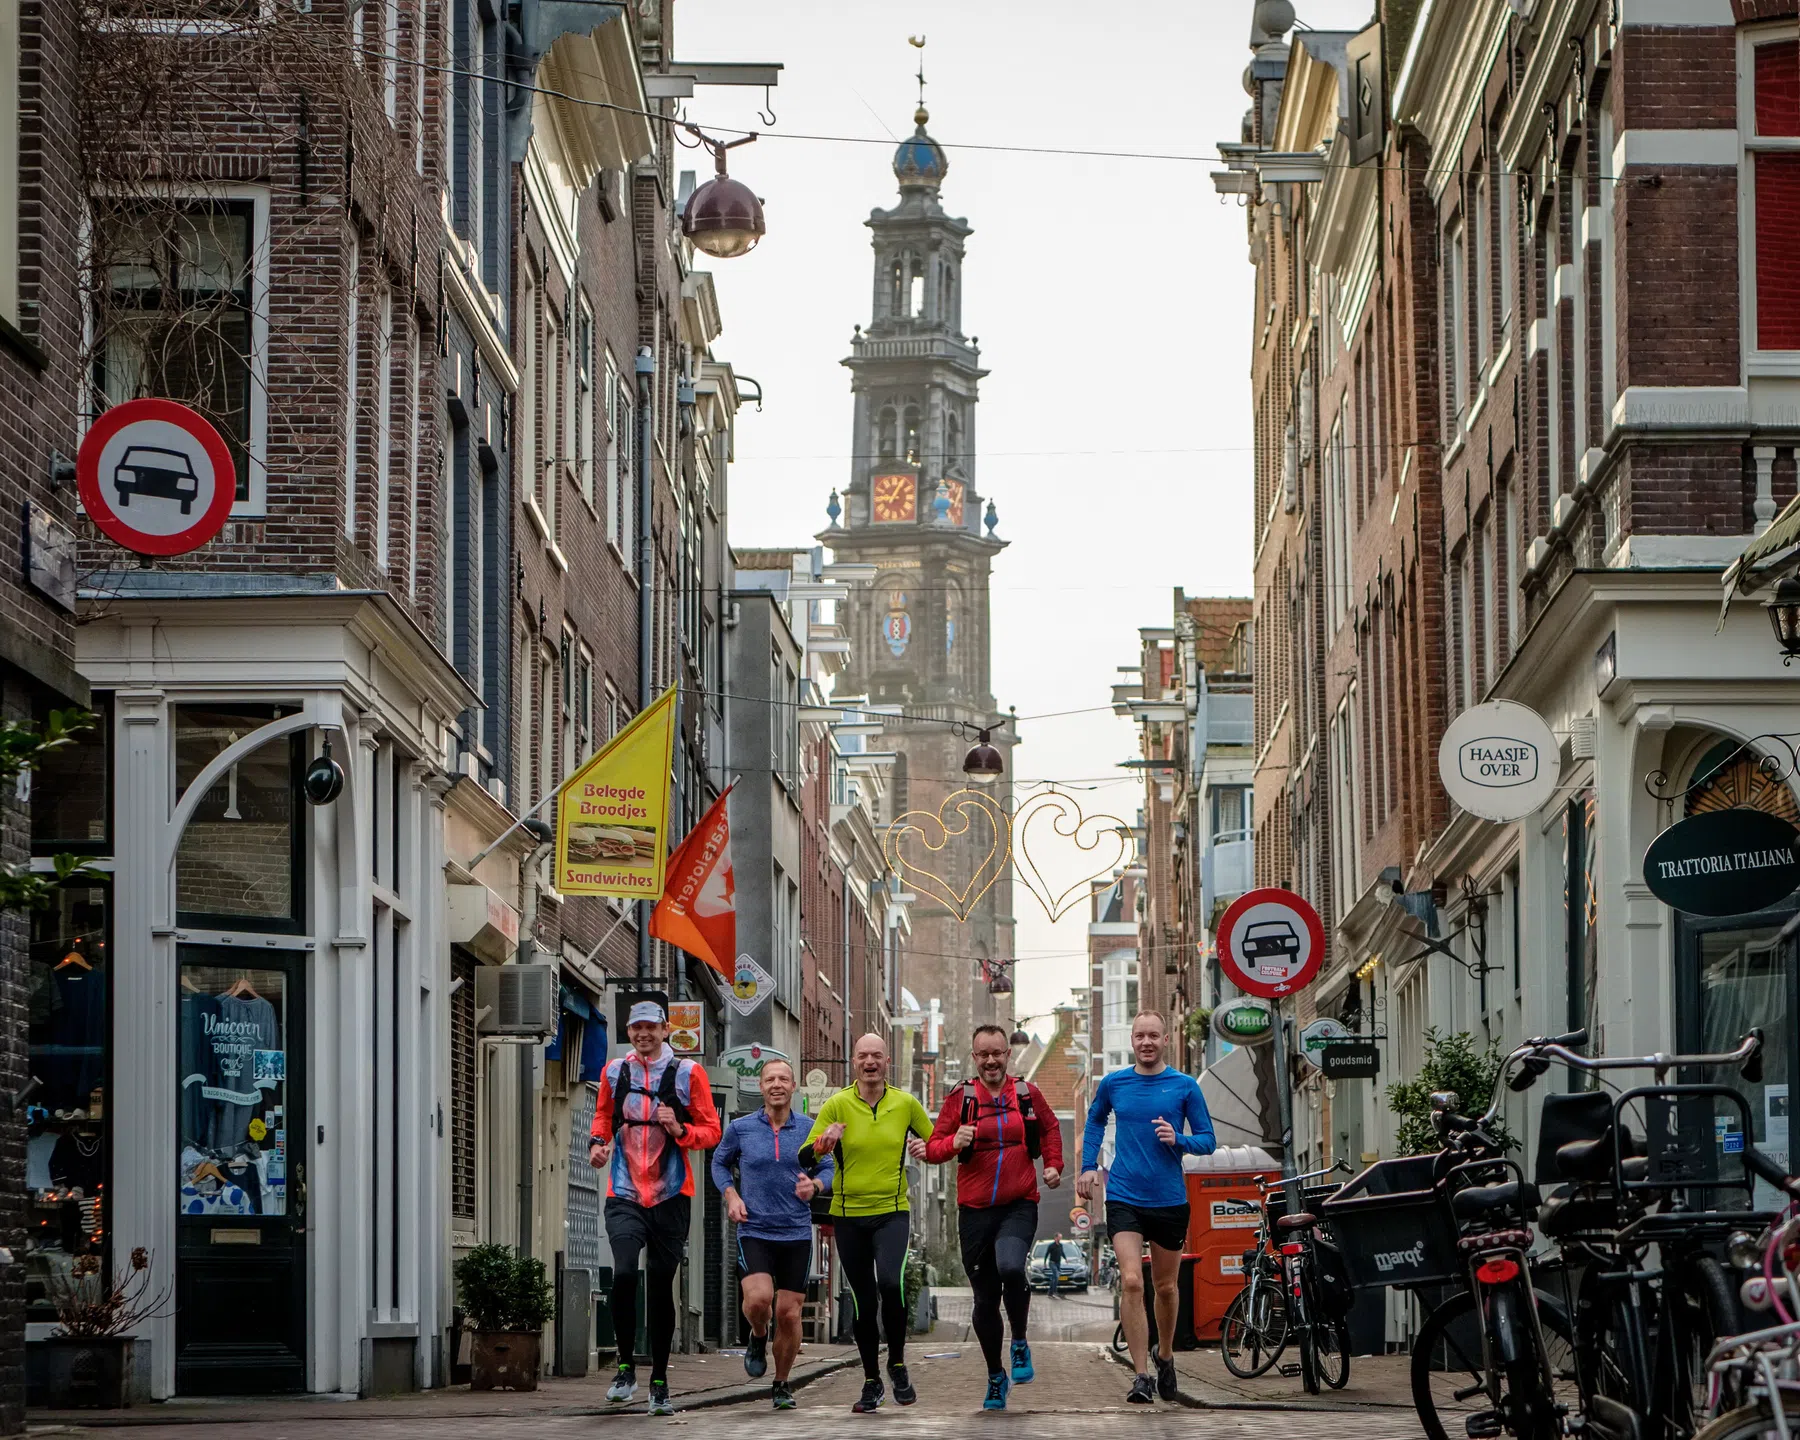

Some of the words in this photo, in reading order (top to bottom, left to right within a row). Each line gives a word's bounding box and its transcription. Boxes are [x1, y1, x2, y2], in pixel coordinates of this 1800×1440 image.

[1470, 748, 1529, 762] HAASJE
[1480, 763, 1521, 776] OVER
[584, 783, 646, 801] Belegde
[580, 801, 647, 820] Broodjes
[1658, 855, 1733, 879] TRATTORIA
[1733, 847, 1796, 871] ITALIANA
[566, 869, 653, 887] Sandwiches
[730, 994, 762, 1005] AMSTERDAM
[201, 1012, 263, 1040] Unicorn
[1227, 1011, 1270, 1029] Brand
[213, 1043, 253, 1056] BOUTIQUE
[727, 1057, 764, 1077] Grol
[1329, 1055, 1373, 1067] goudsmid
[1374, 1246, 1425, 1271] marqt
